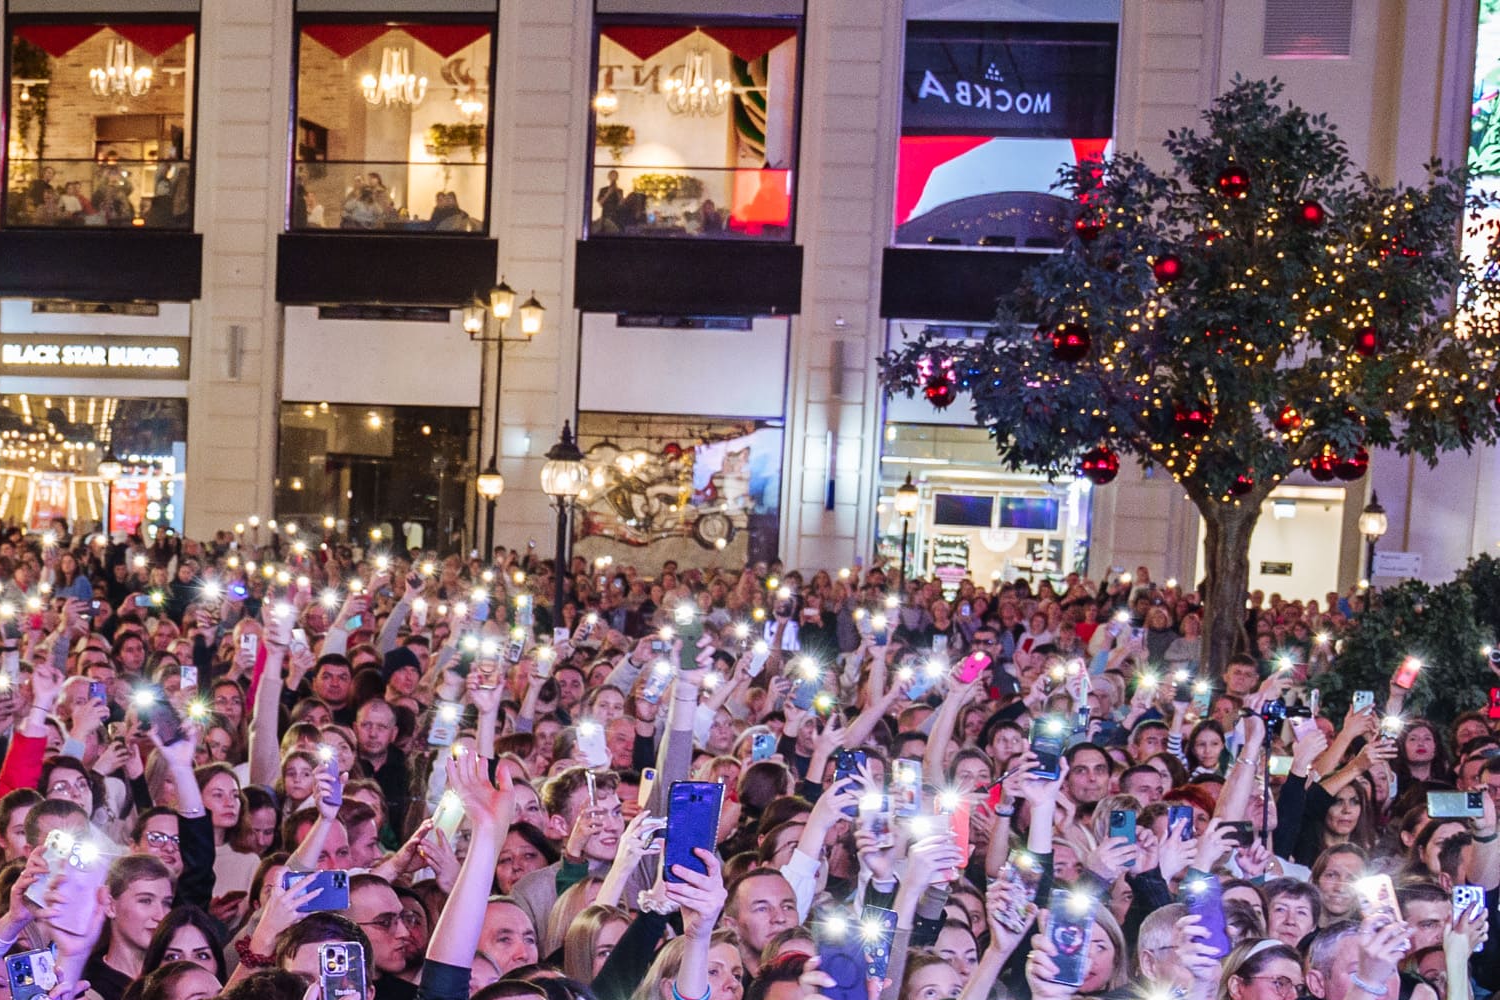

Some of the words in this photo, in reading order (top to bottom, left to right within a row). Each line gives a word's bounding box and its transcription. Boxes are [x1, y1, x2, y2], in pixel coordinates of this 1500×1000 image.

[2, 344, 60, 364] BLACK
[61, 345, 107, 366] STAR
[108, 346, 180, 368] BURGER
